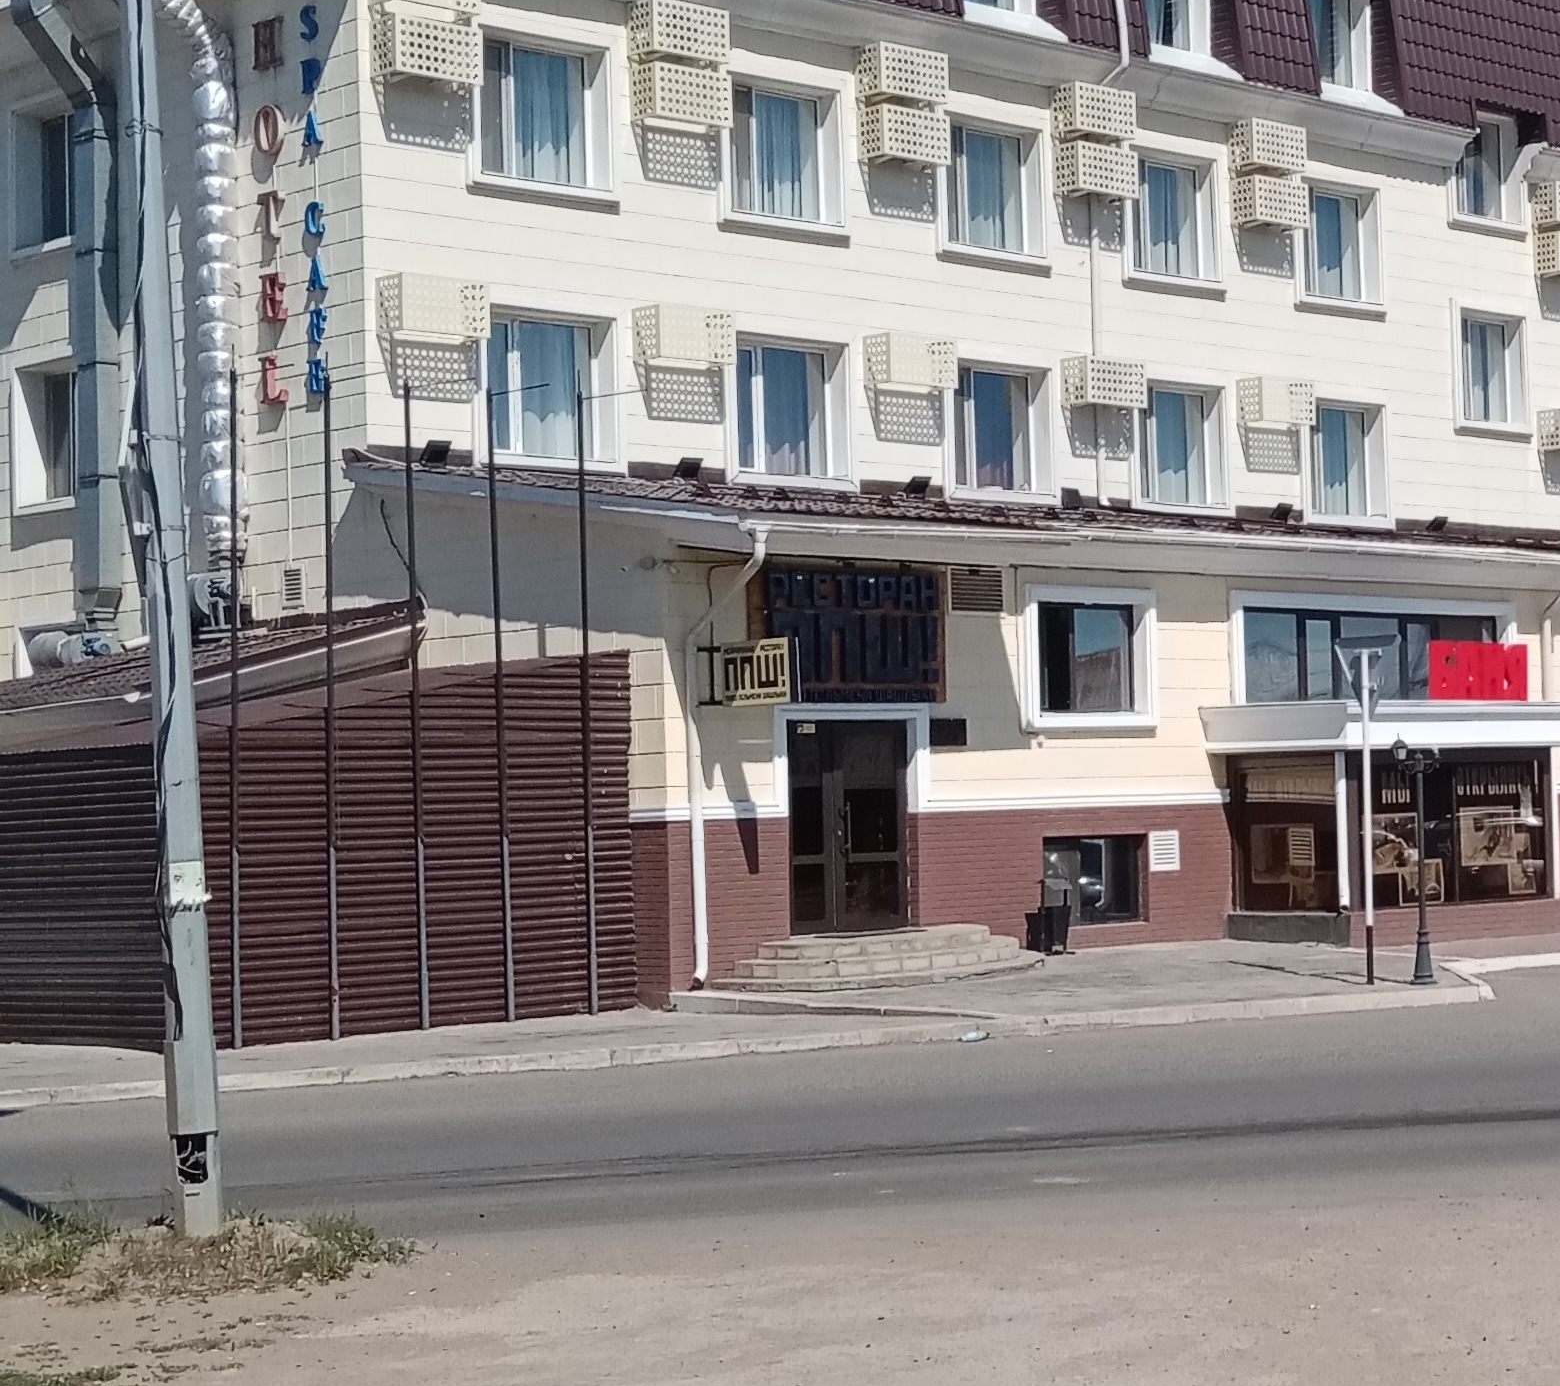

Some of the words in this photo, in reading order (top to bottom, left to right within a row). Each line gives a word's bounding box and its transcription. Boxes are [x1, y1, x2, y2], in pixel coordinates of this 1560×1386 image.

[300, 5, 323, 147] SPA
[252, 16, 289, 404] HOTEL
[304, 201, 329, 394] CAFE
[767, 570, 938, 610] РЕСТОРАН
[724, 653, 786, 691] ППШ!
